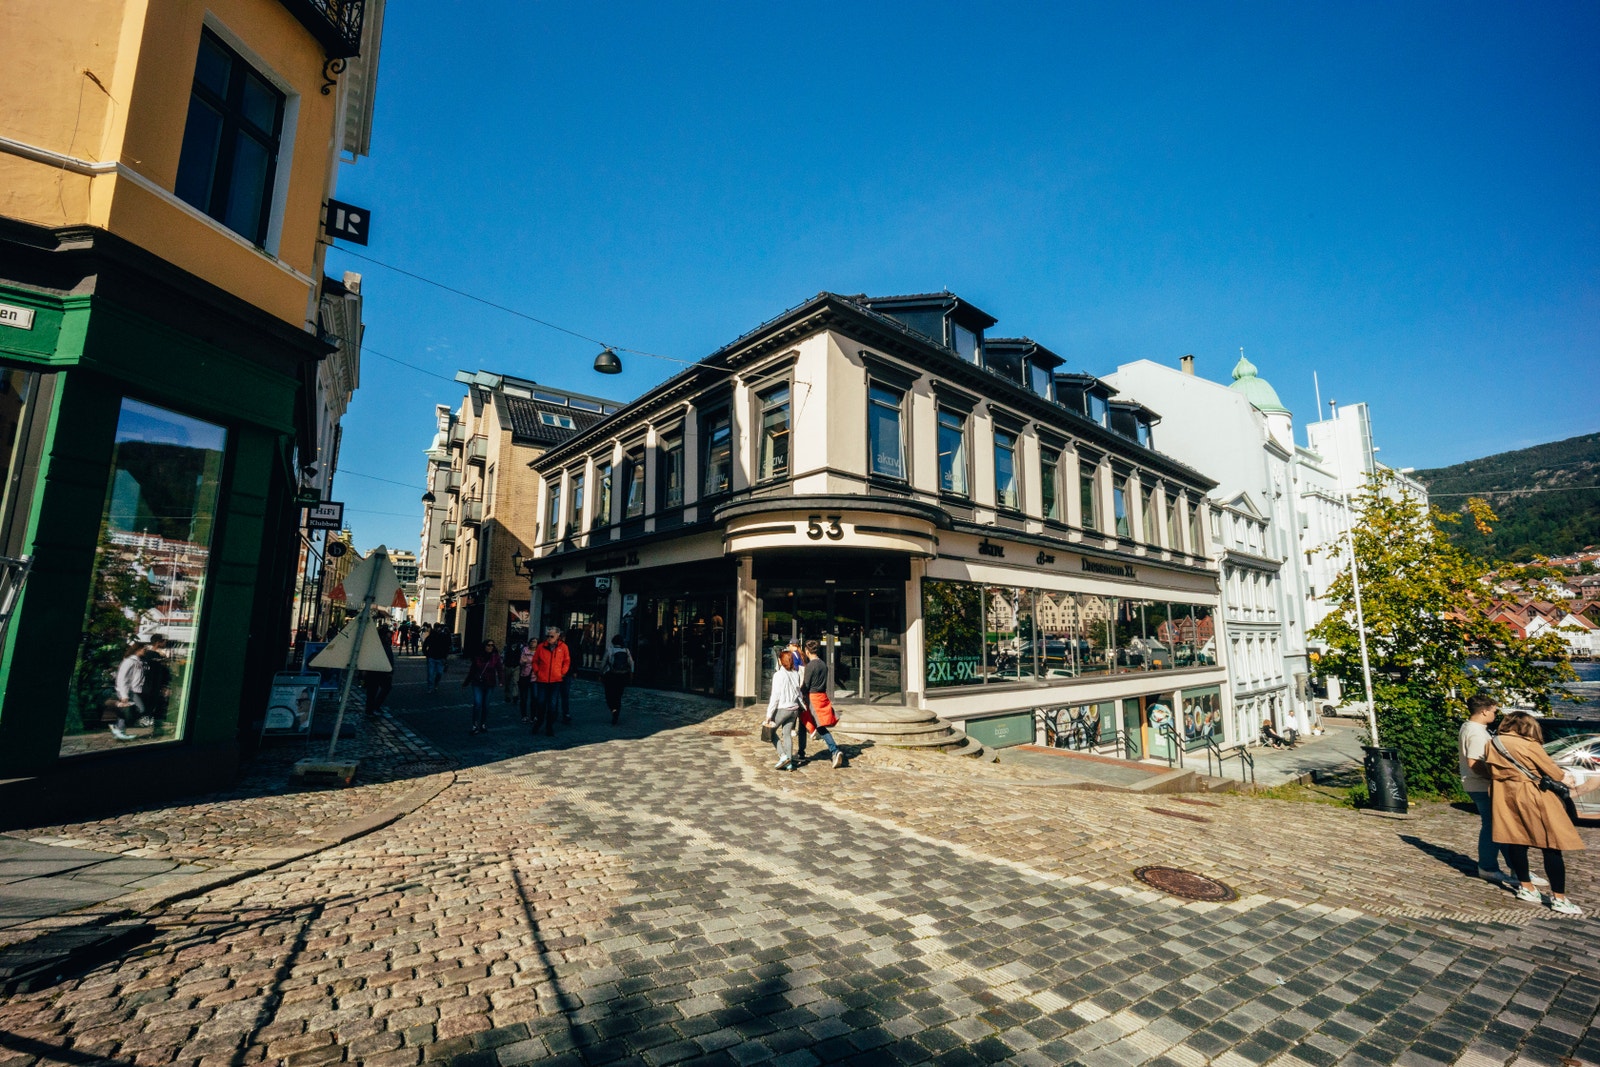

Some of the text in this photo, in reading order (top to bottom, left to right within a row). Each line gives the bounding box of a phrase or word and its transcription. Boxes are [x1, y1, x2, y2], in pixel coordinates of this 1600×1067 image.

[316, 508, 336, 516] HiFi
[309, 519, 339, 528] Klubben
[806, 515, 844, 541] 53
[1081, 557, 1136, 578] Dressmann XL
[928, 661, 980, 682] 2XL-9XL
